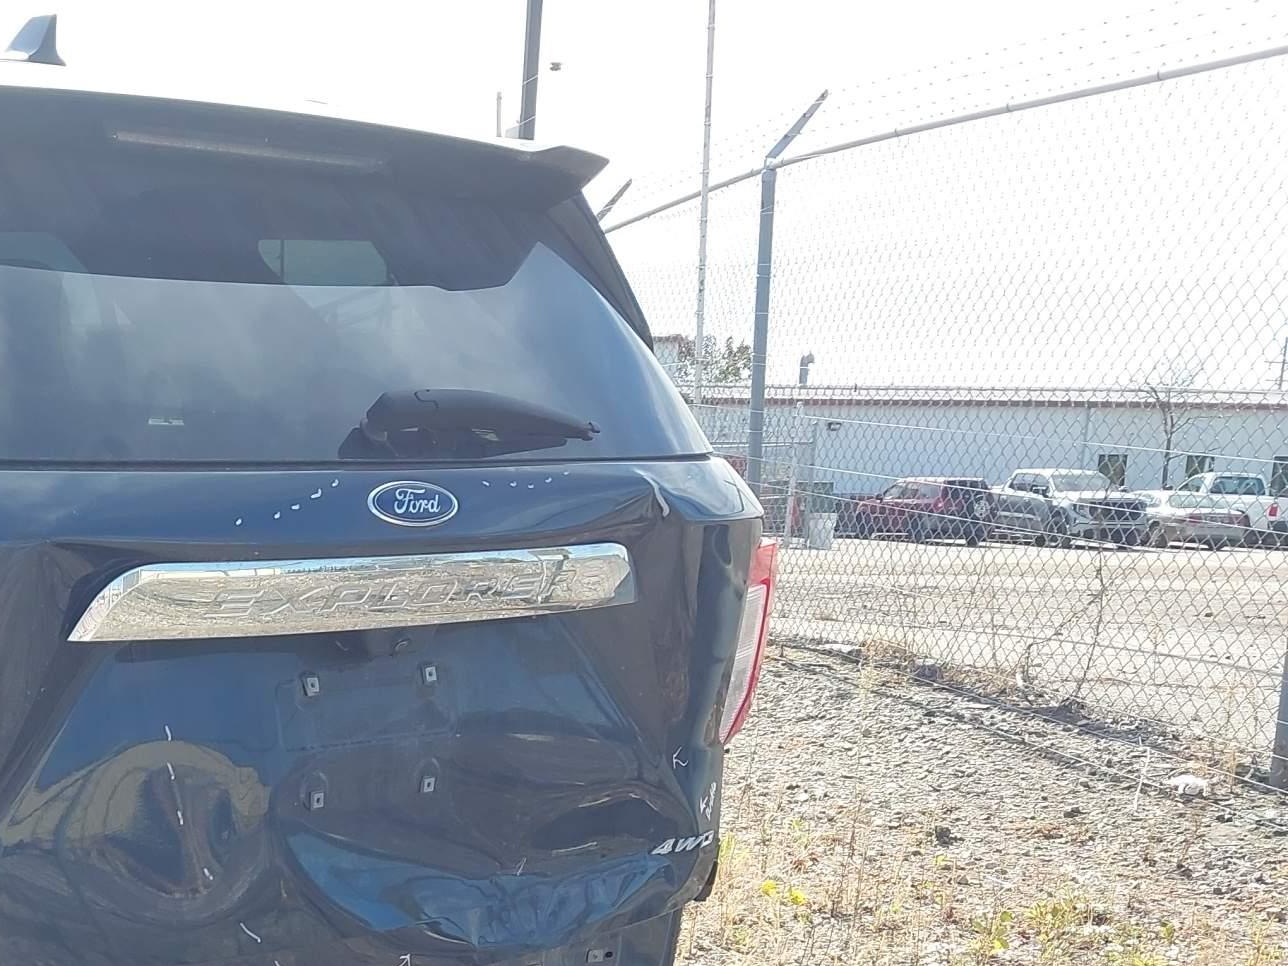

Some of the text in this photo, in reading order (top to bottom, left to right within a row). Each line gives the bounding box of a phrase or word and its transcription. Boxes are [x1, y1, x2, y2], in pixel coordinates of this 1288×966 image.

[394, 488, 440, 514] Ford
[205, 566, 579, 619] EXPLORER
[650, 830, 715, 856] 4WD
